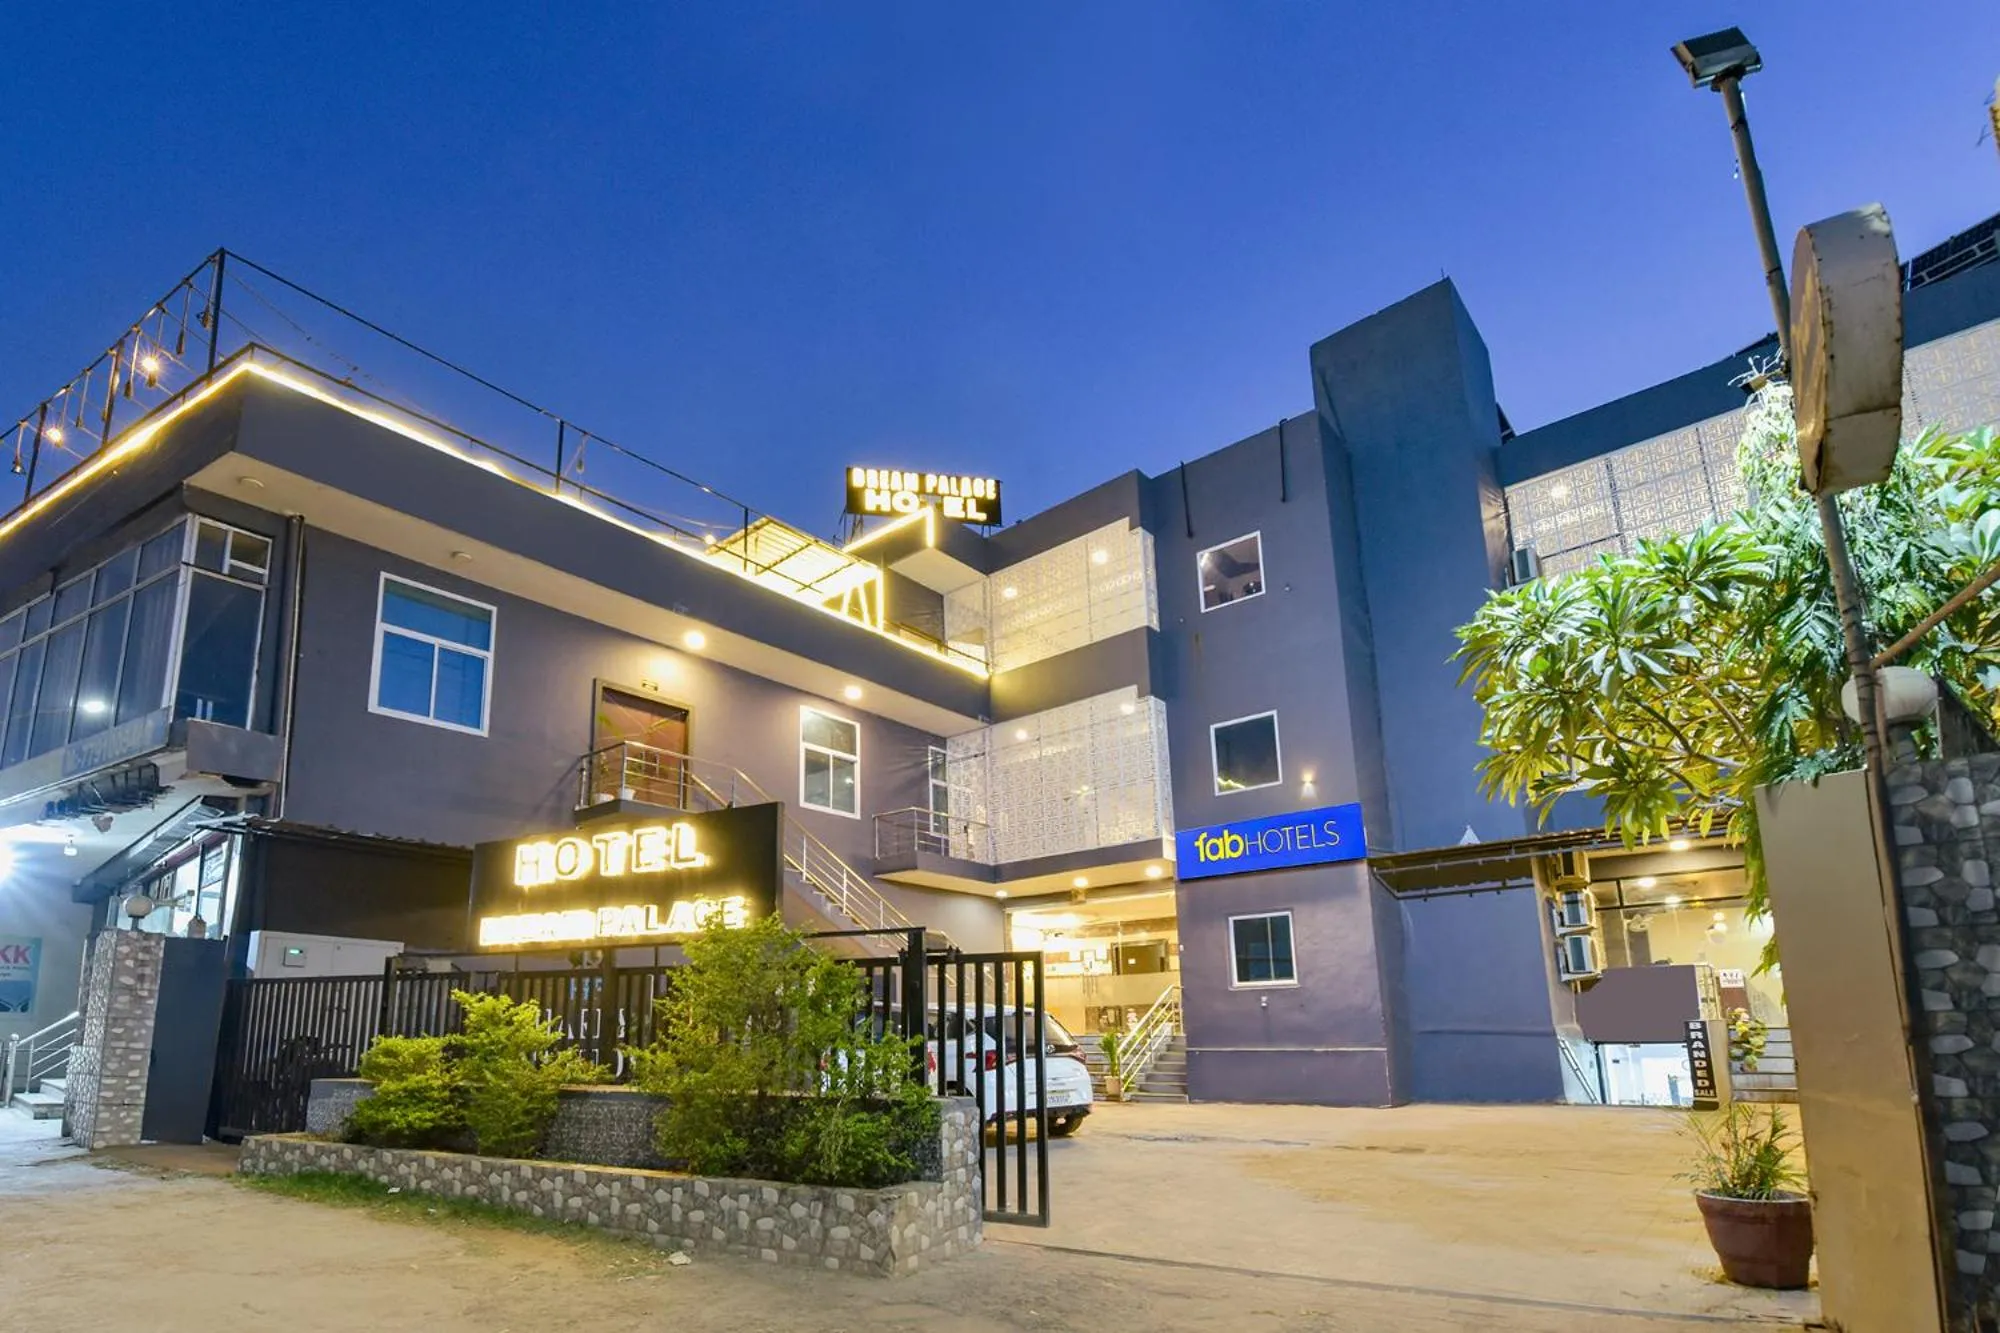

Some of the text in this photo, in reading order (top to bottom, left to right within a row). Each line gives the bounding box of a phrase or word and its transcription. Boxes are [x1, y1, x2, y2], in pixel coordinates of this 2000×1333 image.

[924, 473, 997, 500] PALACE
[514, 822, 705, 886] HOTEL
[1194, 820, 1340, 862] fabHOTELS
[595, 895, 751, 938] PALACE
[1688, 1021, 1710, 1088] BRANDED
